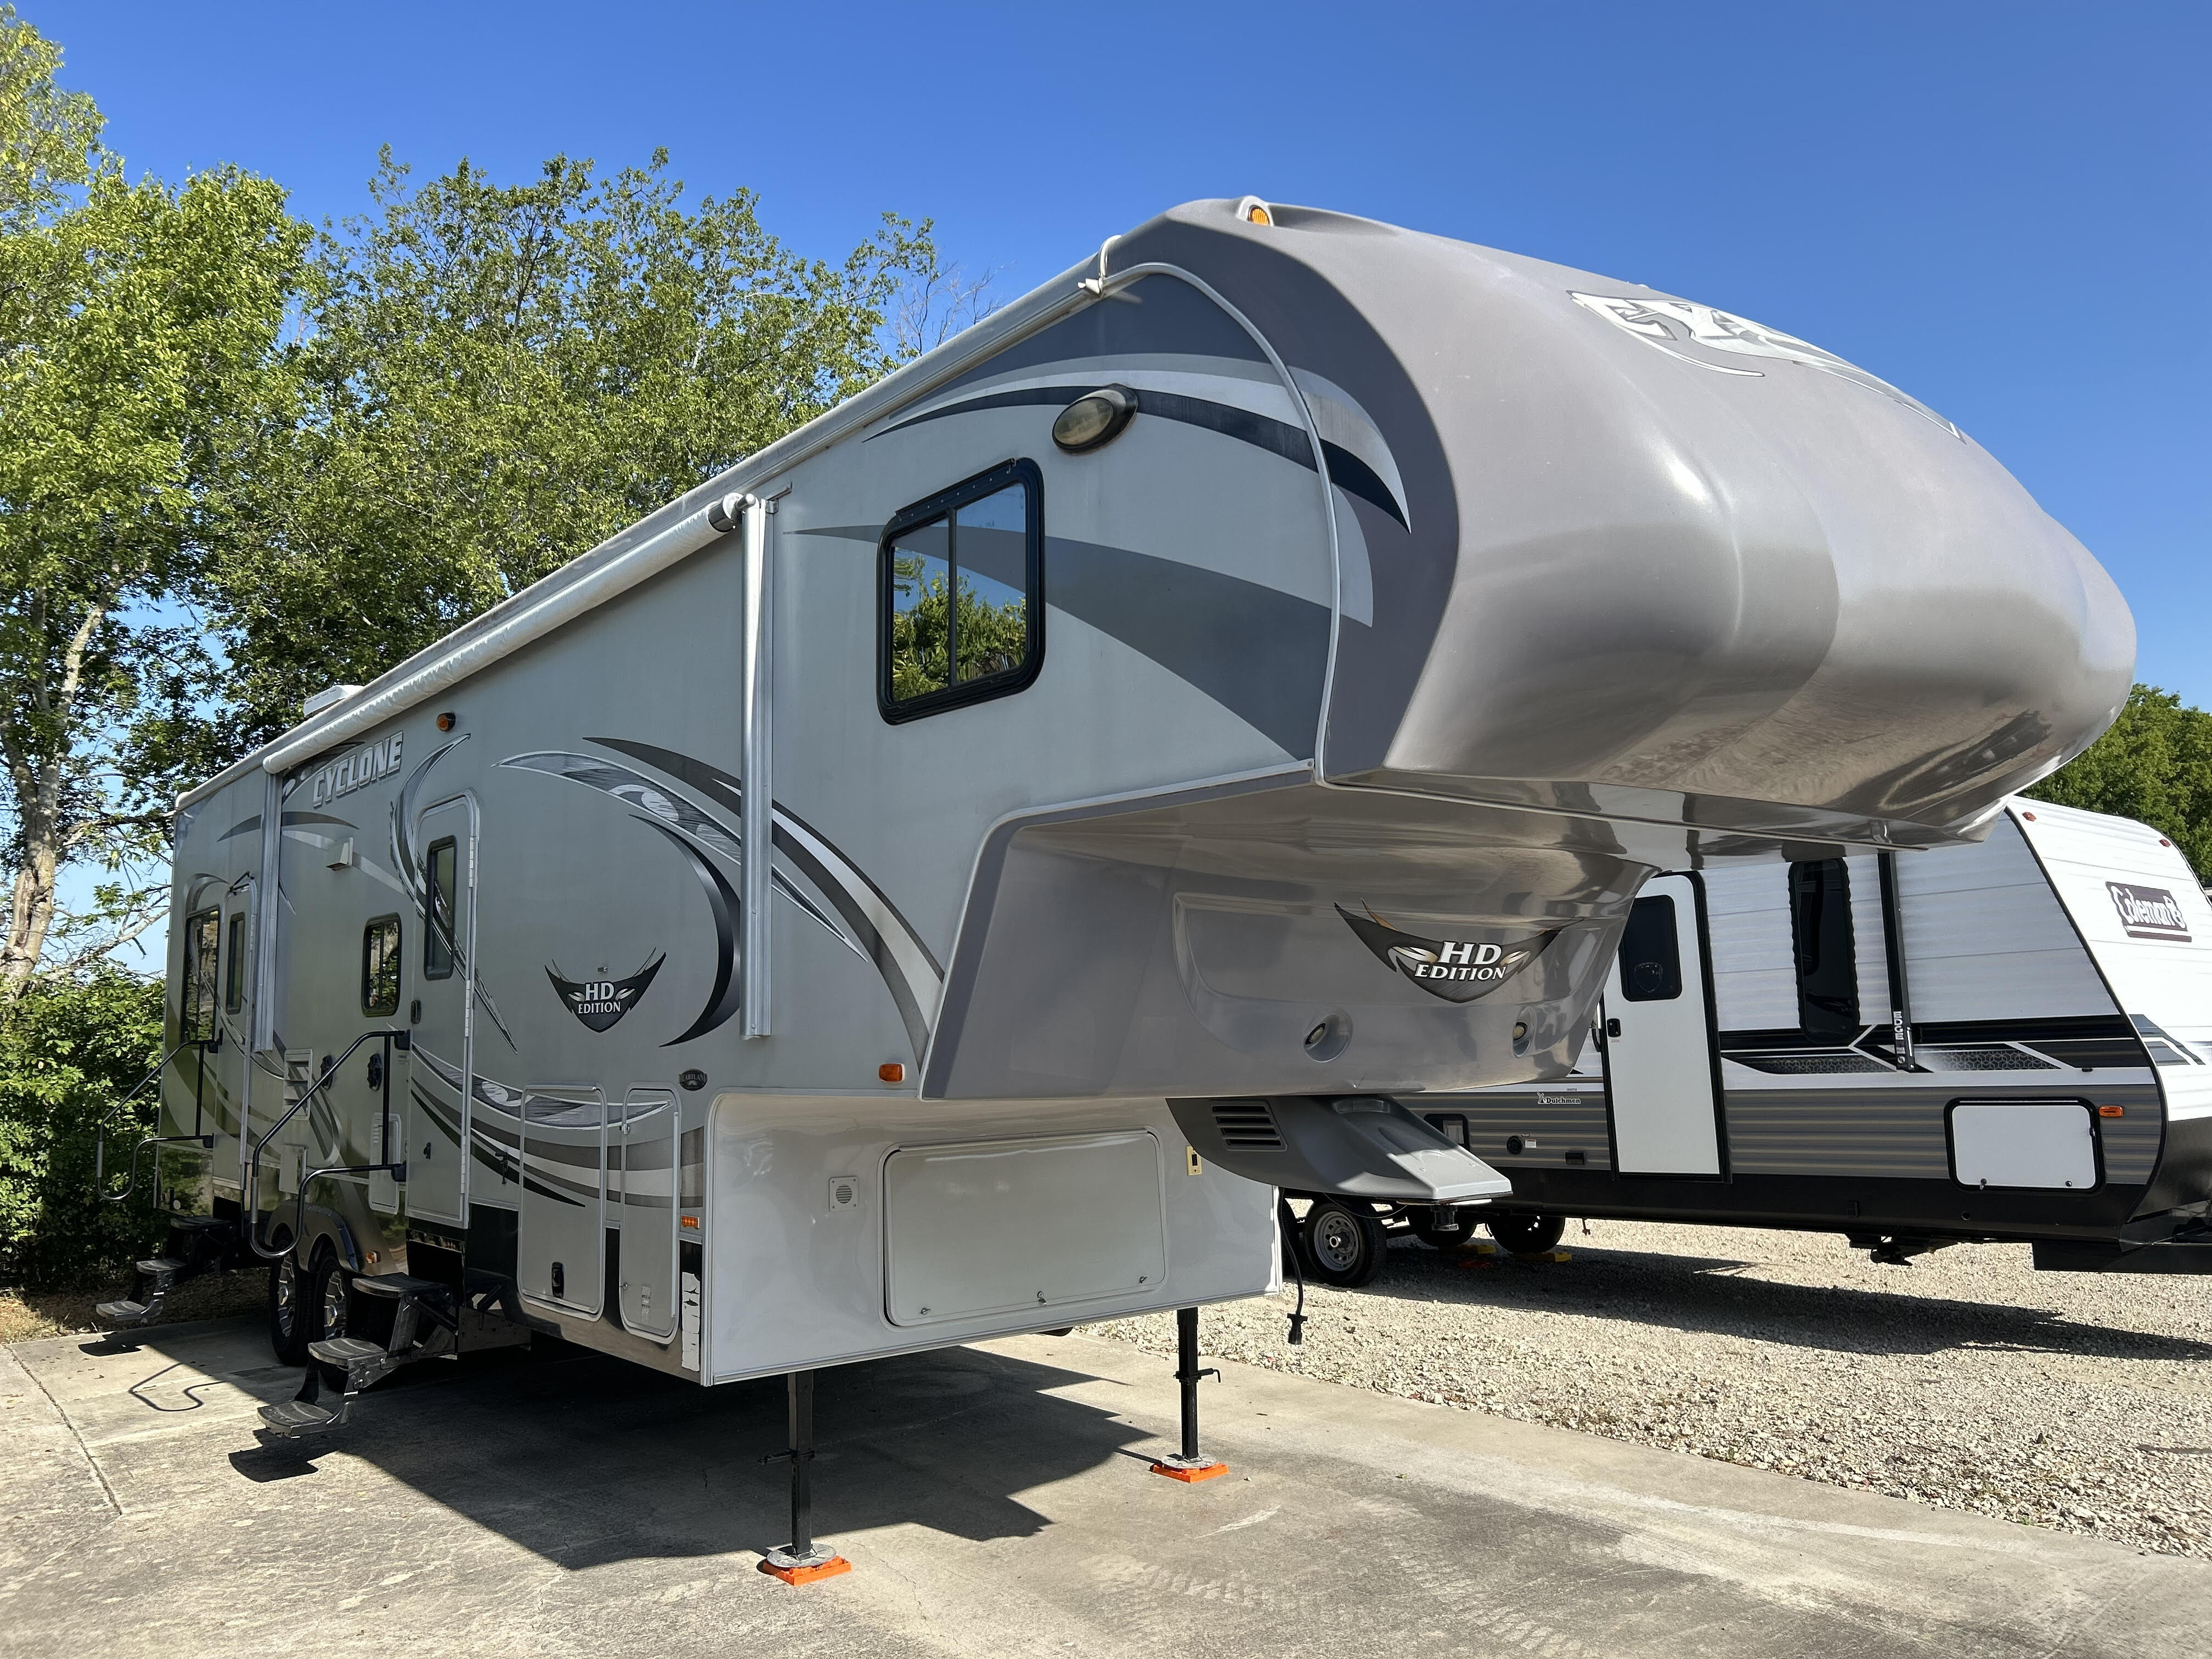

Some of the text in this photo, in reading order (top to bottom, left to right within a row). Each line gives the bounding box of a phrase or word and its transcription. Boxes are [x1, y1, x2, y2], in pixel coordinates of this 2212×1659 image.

[313, 731, 403, 808] CYCLONE
[2111, 885, 2176, 926] Coleman
[1438, 941, 1502, 965] HD
[1414, 964, 1506, 980] EDITION
[585, 981, 614, 1001] HD
[578, 1002, 621, 1014] EDITION
[1893, 1011, 1904, 1040] EDGE
[679, 1074, 708, 1084] HEARTLAND
